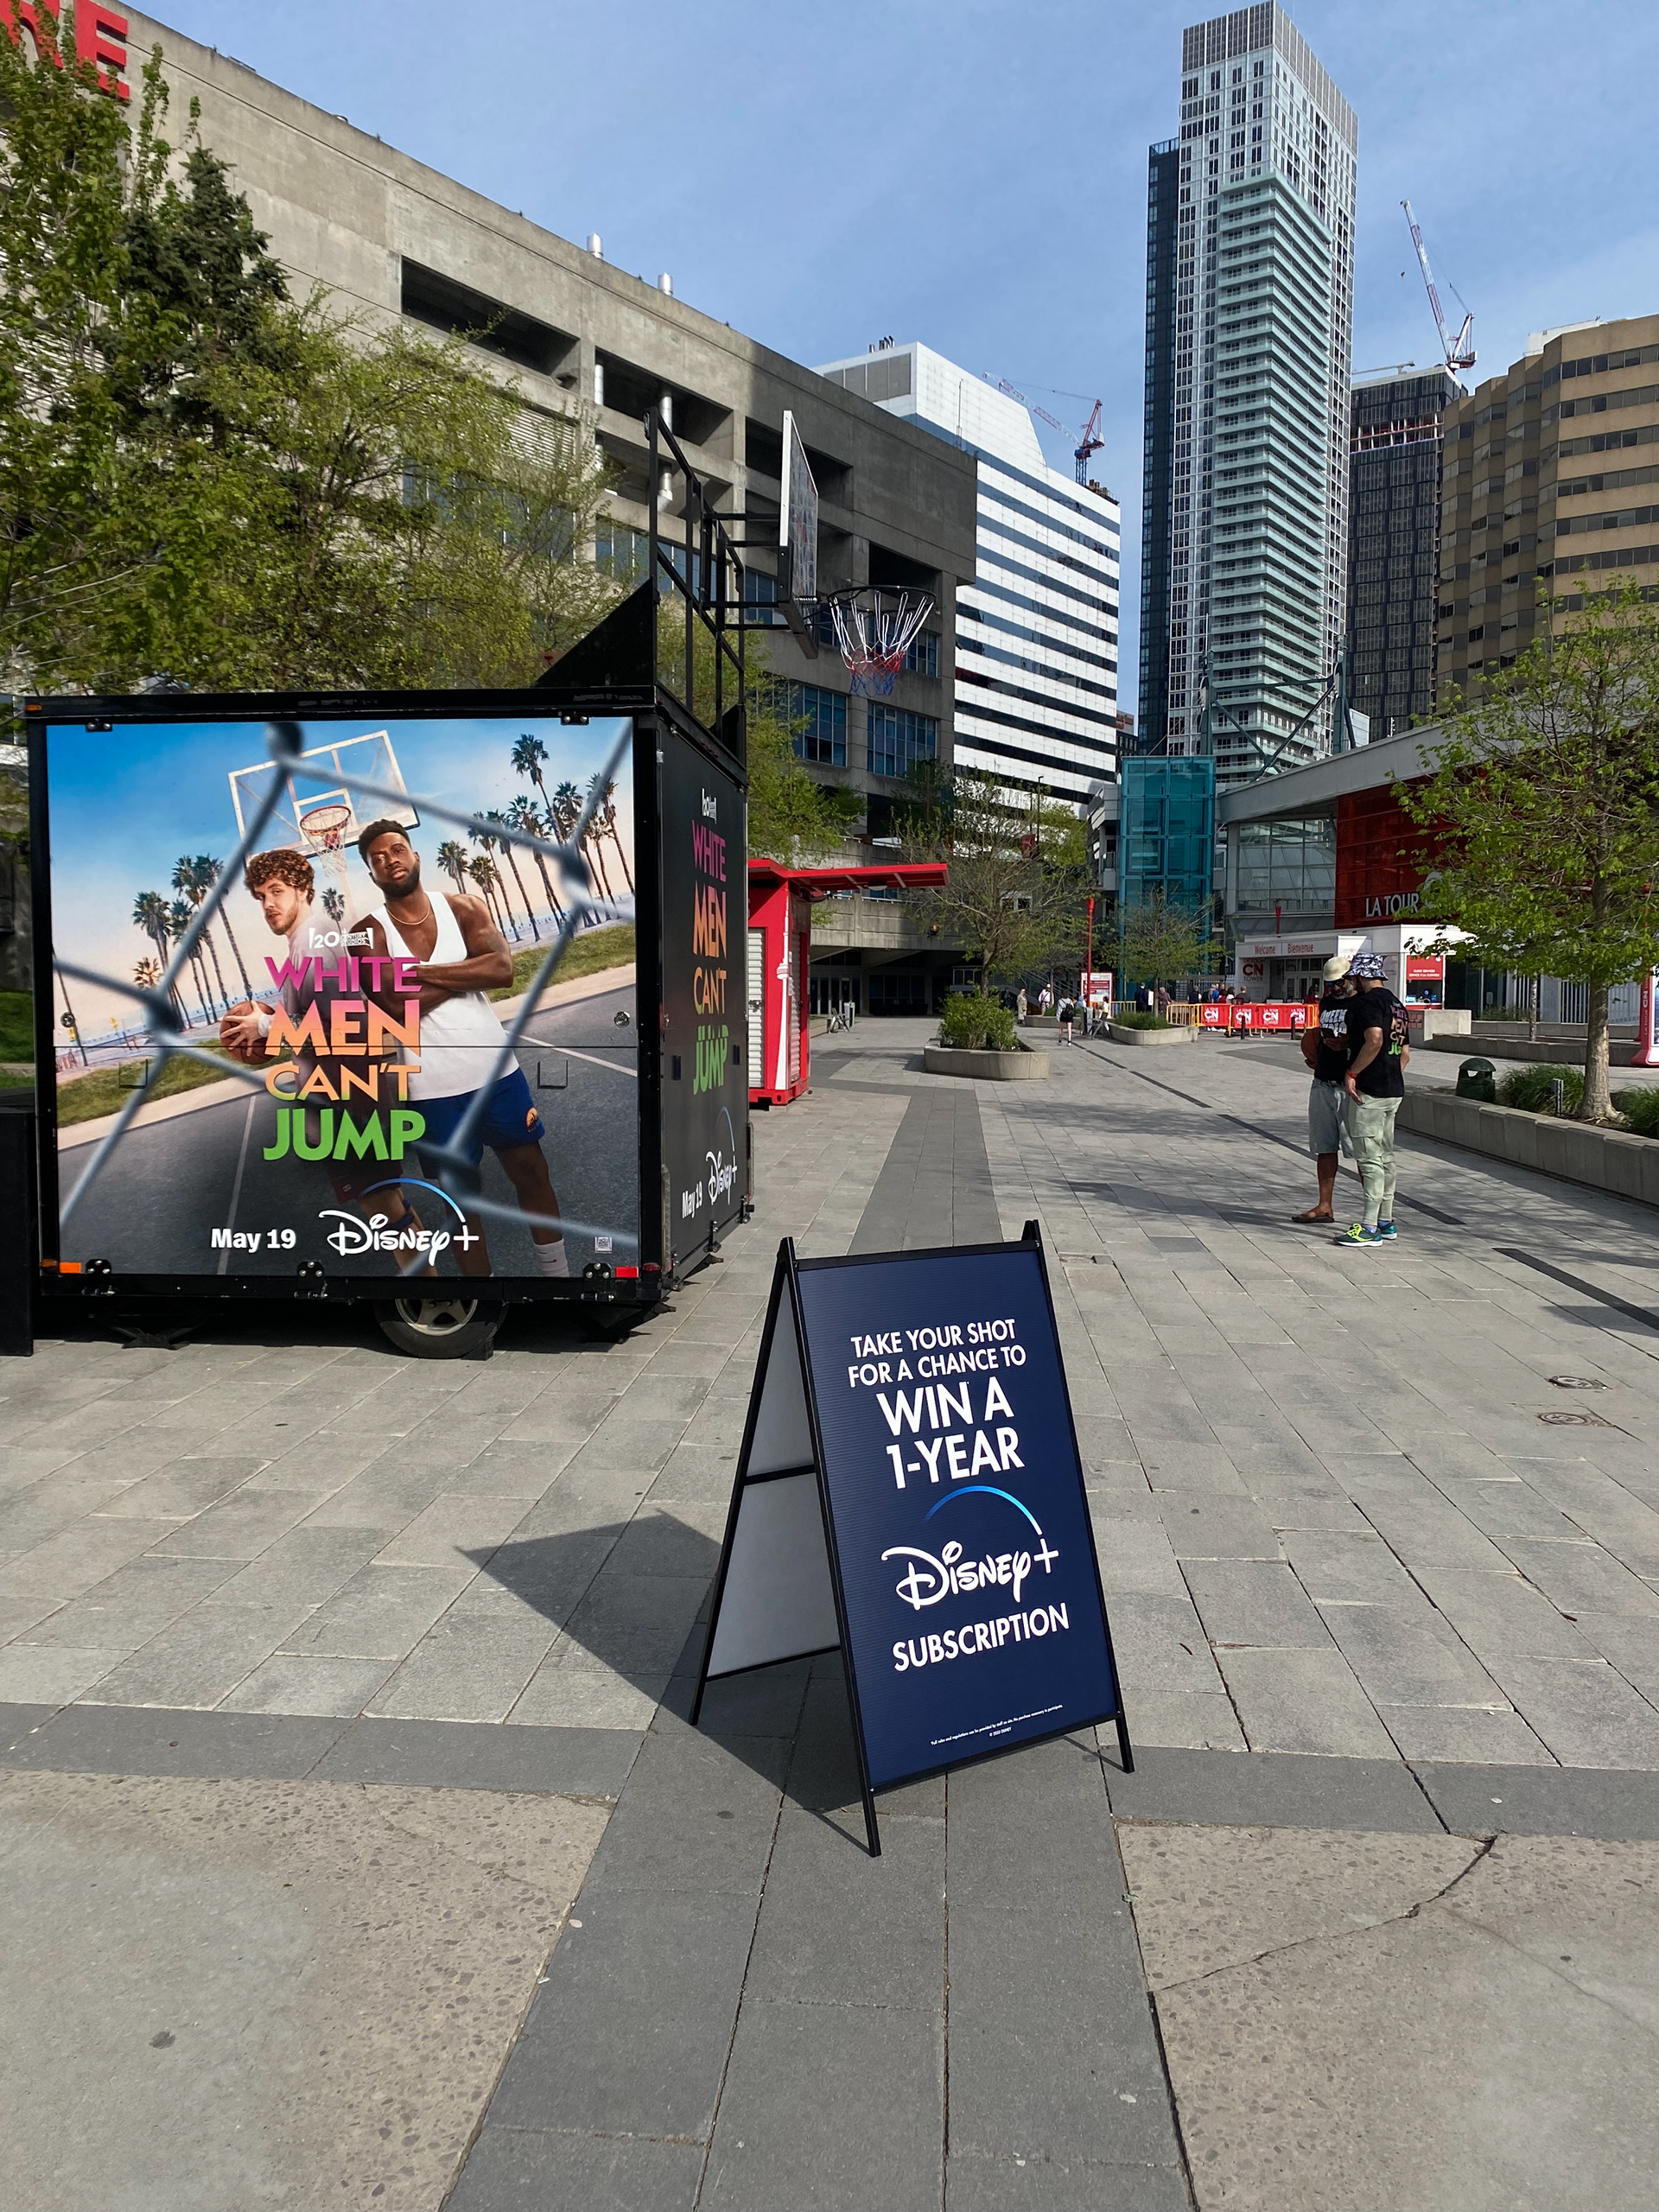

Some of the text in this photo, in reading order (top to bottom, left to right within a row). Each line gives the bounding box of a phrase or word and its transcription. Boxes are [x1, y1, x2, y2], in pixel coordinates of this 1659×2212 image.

[692, 820, 726, 882] WHITE
[693, 879, 727, 959] MEN
[1366, 893, 1419, 917] LA TOUR
[314, 931, 340, 948] 20
[1255, 944, 1275, 954] Welcome
[1287, 943, 1314, 954] Bienvenue
[264, 957, 423, 992] WHITE
[1243, 963, 1264, 976] CN
[1205, 1011, 1218, 1020] CN
[1263, 1012, 1278, 1021] CN
[1643, 991, 1648, 1008] CN
[264, 999, 422, 1058] MEN
[693, 1024, 729, 1095] JUMP
[265, 1062, 422, 1102] CAN'T
[263, 1108, 426, 1161] JUMP
[682, 1181, 703, 1219] May 19
[211, 1228, 296, 1253] May 19
[851, 1319, 1015, 1358] TAKE YOUR SHOT
[848, 1344, 1026, 1388] FOR A CHANCE TO
[876, 1376, 1014, 1436] WIN A
[886, 1427, 1025, 1489] 1-YEAR
[893, 1602, 1069, 1672] SUBSCRIPTION
